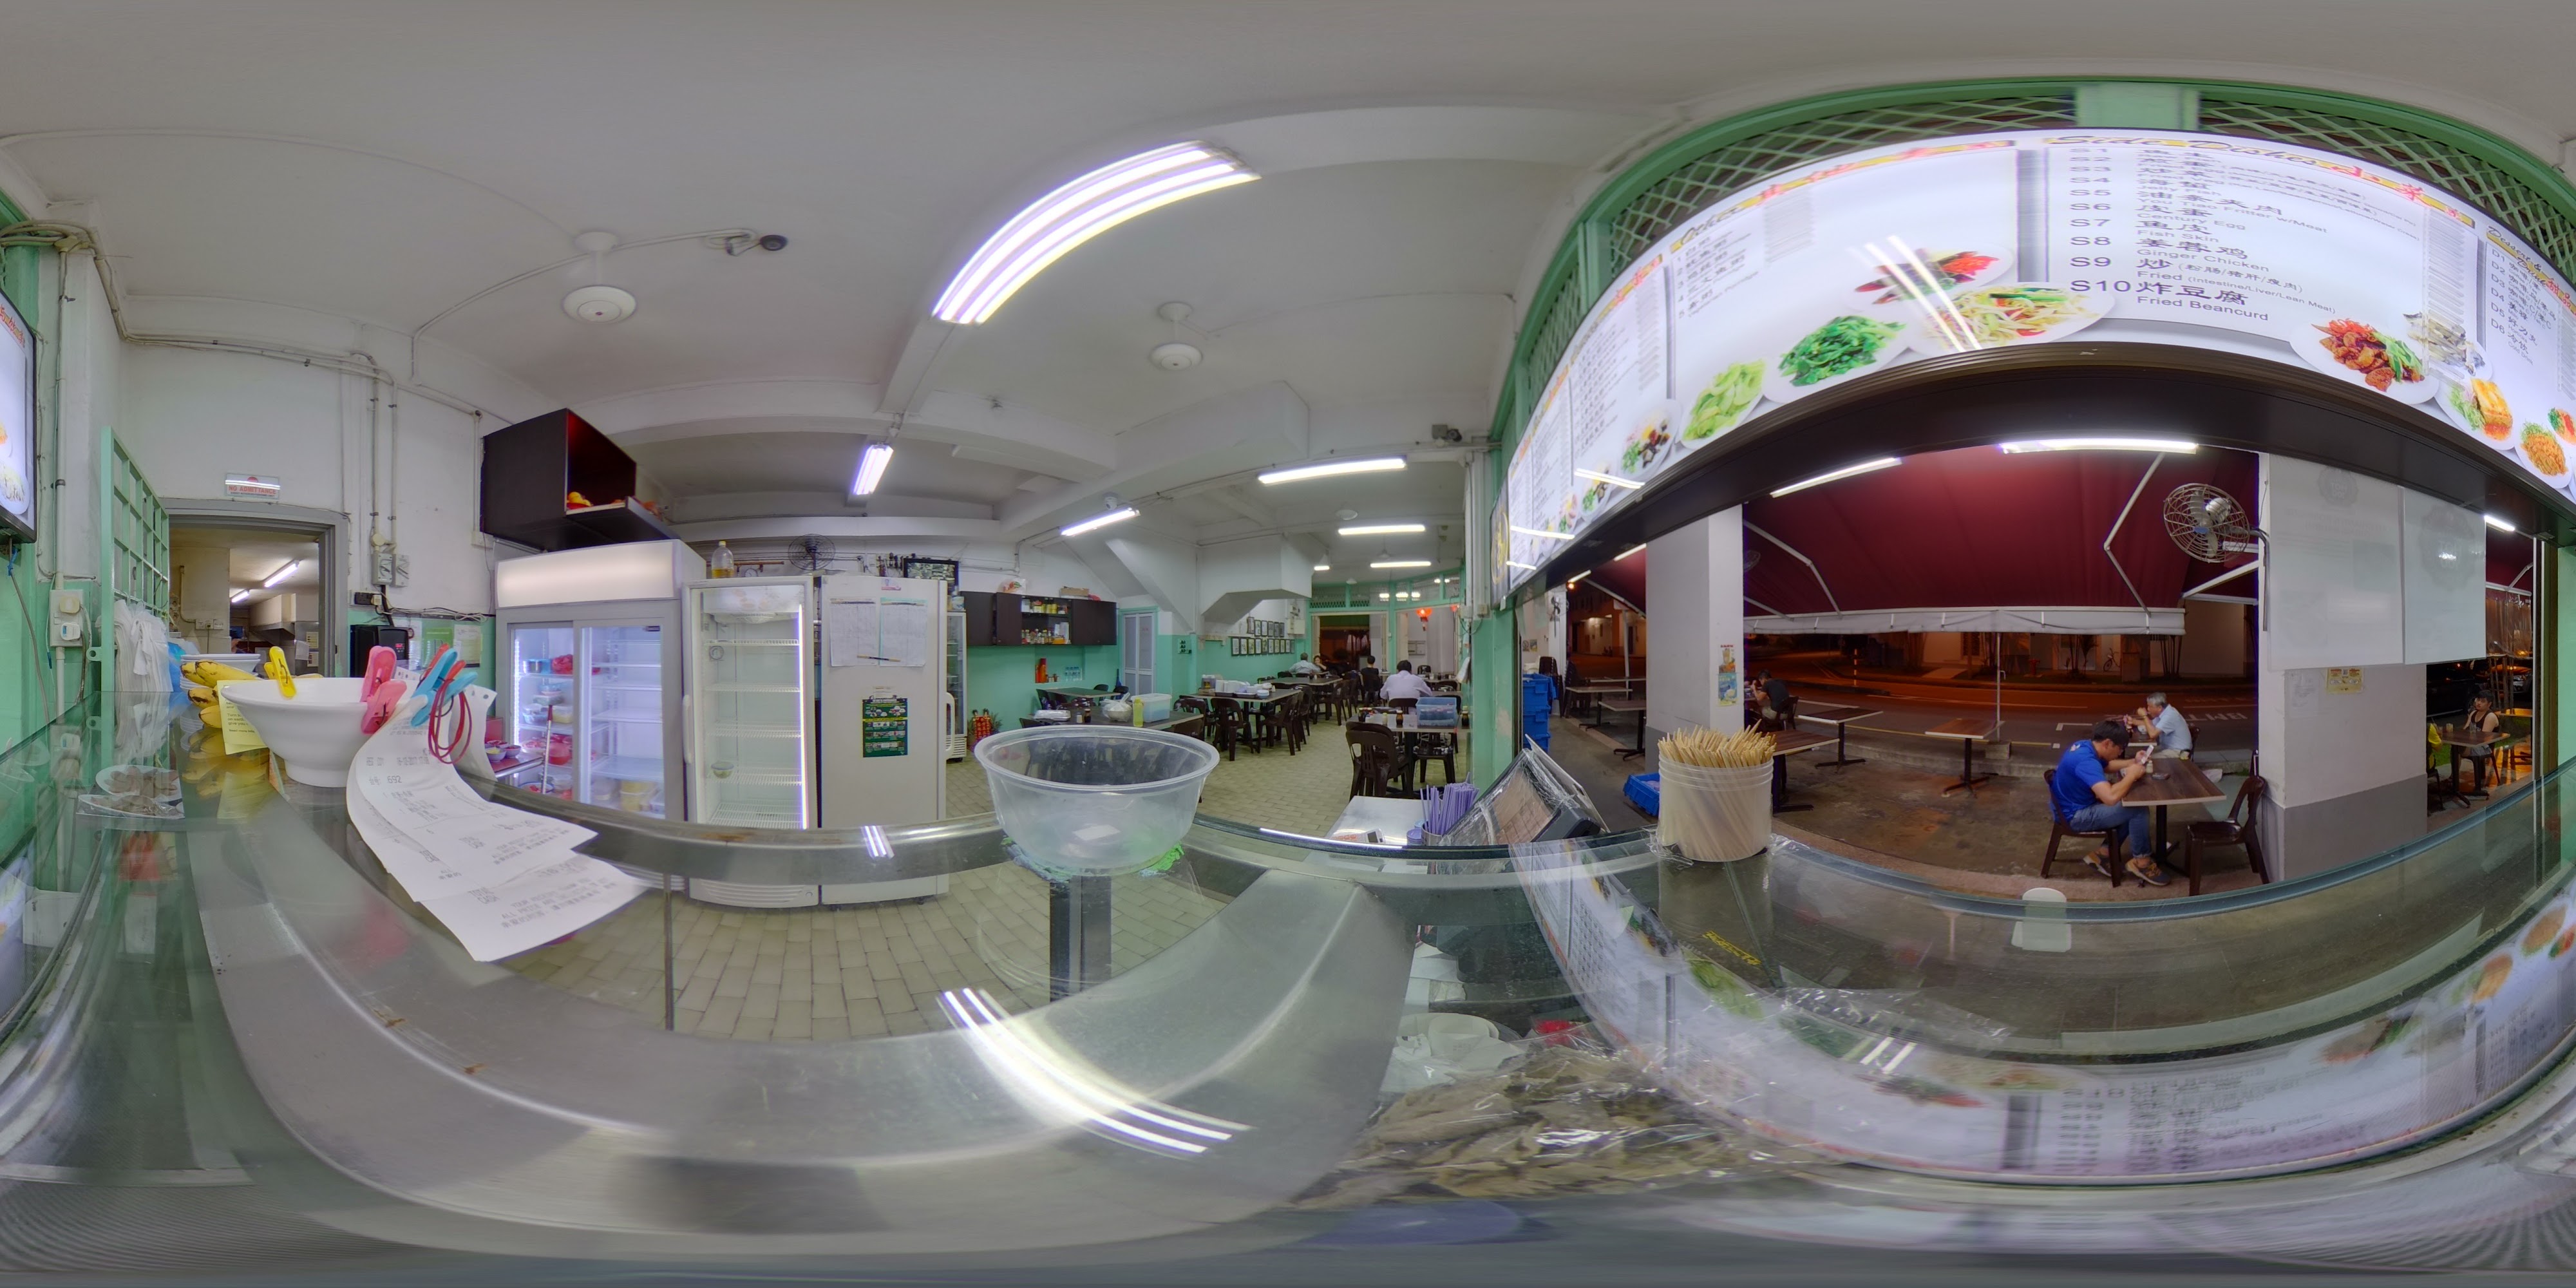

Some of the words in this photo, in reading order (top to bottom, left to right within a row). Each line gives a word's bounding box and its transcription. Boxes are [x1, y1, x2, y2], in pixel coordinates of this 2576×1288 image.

[2047, 136, 2163, 145] Side
[2188, 140, 2316, 166] Dishes
[2186, 188, 2222, 196] Fish
[2137, 213, 2208, 225] Century
[2214, 220, 2246, 231] Egg
[2182, 201, 2218, 211] Tiao
[2224, 206, 2274, 218] Fritter
[2276, 216, 2328, 233] w/Meat
[2070, 236, 2111, 245] S8
[2137, 229, 2175, 238] Fish
[2182, 233, 2219, 243] Skin
[2488, 225, 2531, 261] Dessert
[2533, 263, 2542, 272] &
[2492, 248, 2505, 263] D1
[2070, 256, 2111, 267] S9
[2136, 258, 2174, 270] 炒
[2137, 249, 2198, 260] Ginger
[2204, 254, 2269, 272] Chicken
[2492, 261, 2505, 276] D2
[2491, 273, 2505, 289] D3
[2070, 280, 2131, 292] S10
[2136, 281, 2249, 306] 炸豆腐
[2137, 270, 2183, 281] Fried
[2188, 276, 2306, 305] (Intestine/Liver/Lean
[2308, 299, 2336, 314] Meat)
[2491, 287, 2505, 302] D4
[2137, 296, 2183, 307] Fried
[2190, 300, 2269, 321] Beancurd
[2491, 302, 2505, 317] D5
[2491, 318, 2505, 334] D6
[239, 486, 276, 495] ADMITTANCE
[387, 775, 402, 784] 692
